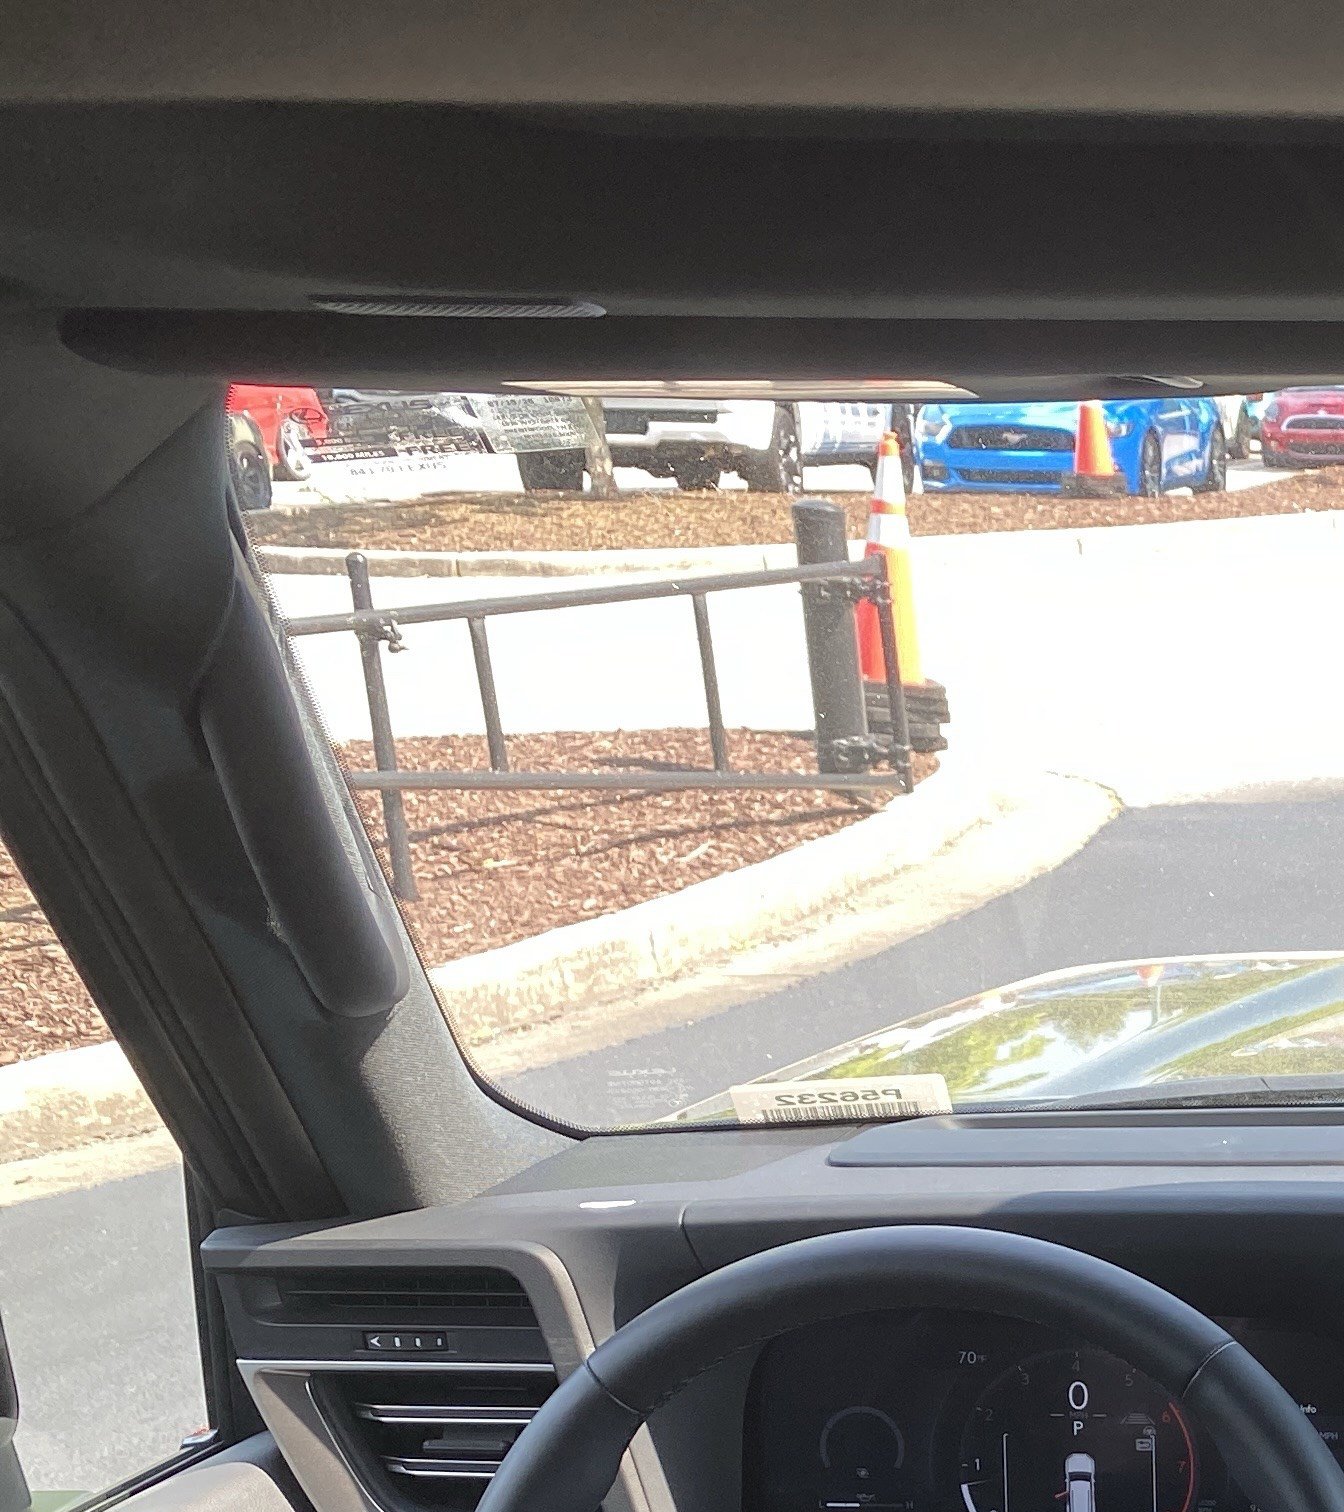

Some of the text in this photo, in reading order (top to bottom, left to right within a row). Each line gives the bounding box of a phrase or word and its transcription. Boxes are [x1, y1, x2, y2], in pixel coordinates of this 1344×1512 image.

[1072, 1360, 1080, 1372] 4
[1021, 1373, 1030, 1386] 3
[1125, 1374, 1134, 1387] 5
[1068, 1381, 1089, 1411] 0
[985, 1409, 994, 1422] 2
[1162, 1411, 1171, 1423] 6
[1073, 1421, 1084, 1436] P
[974, 1458, 981, 1471] 1
